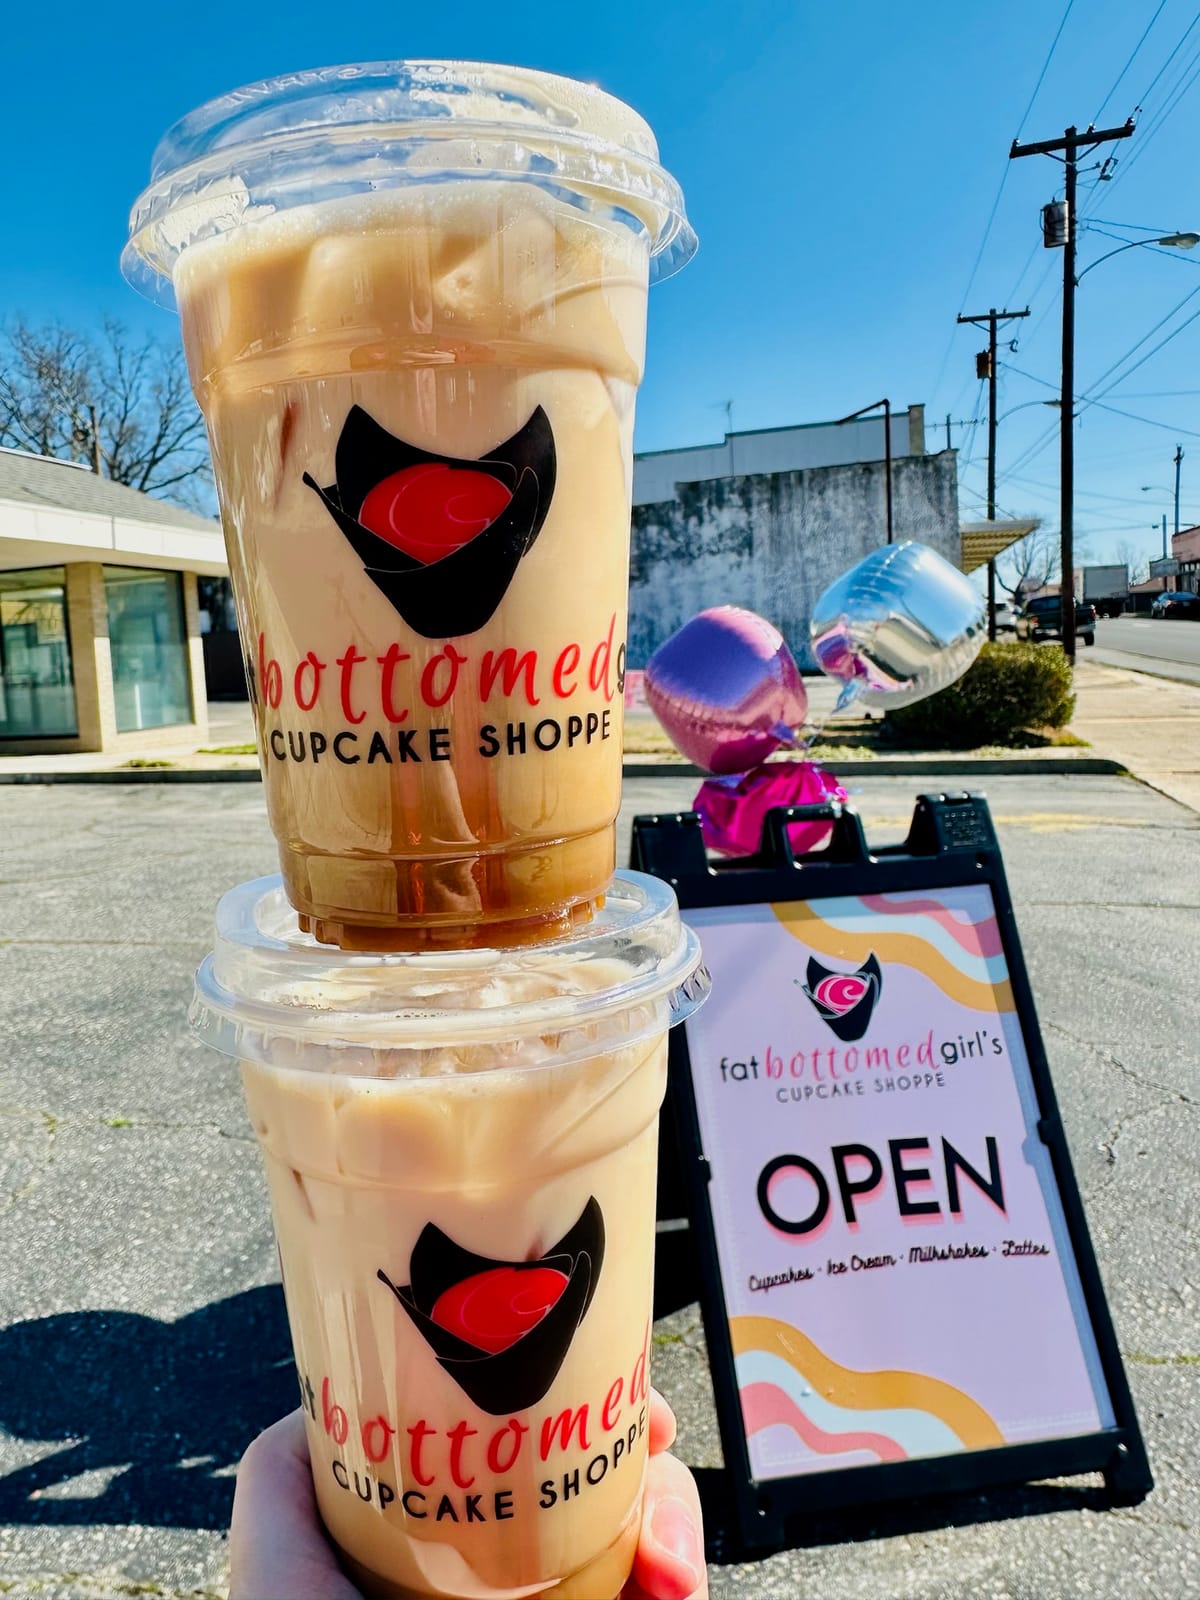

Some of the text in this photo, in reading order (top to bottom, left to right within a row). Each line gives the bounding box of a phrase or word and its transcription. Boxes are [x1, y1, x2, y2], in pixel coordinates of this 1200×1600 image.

[258, 612, 617, 725] bottomed
[270, 709, 612, 764] CUPCAKE SHOPPE
[775, 1071, 946, 1103] CUPCAKE SHOPPE
[756, 1135, 1008, 1240] OPEN
[749, 1238, 1050, 1292] Cupcakes Ice Cream Milkshakes Lattes
[321, 1316, 650, 1489] bottomed
[331, 1404, 646, 1523] CUPCAKE SHOPPE
